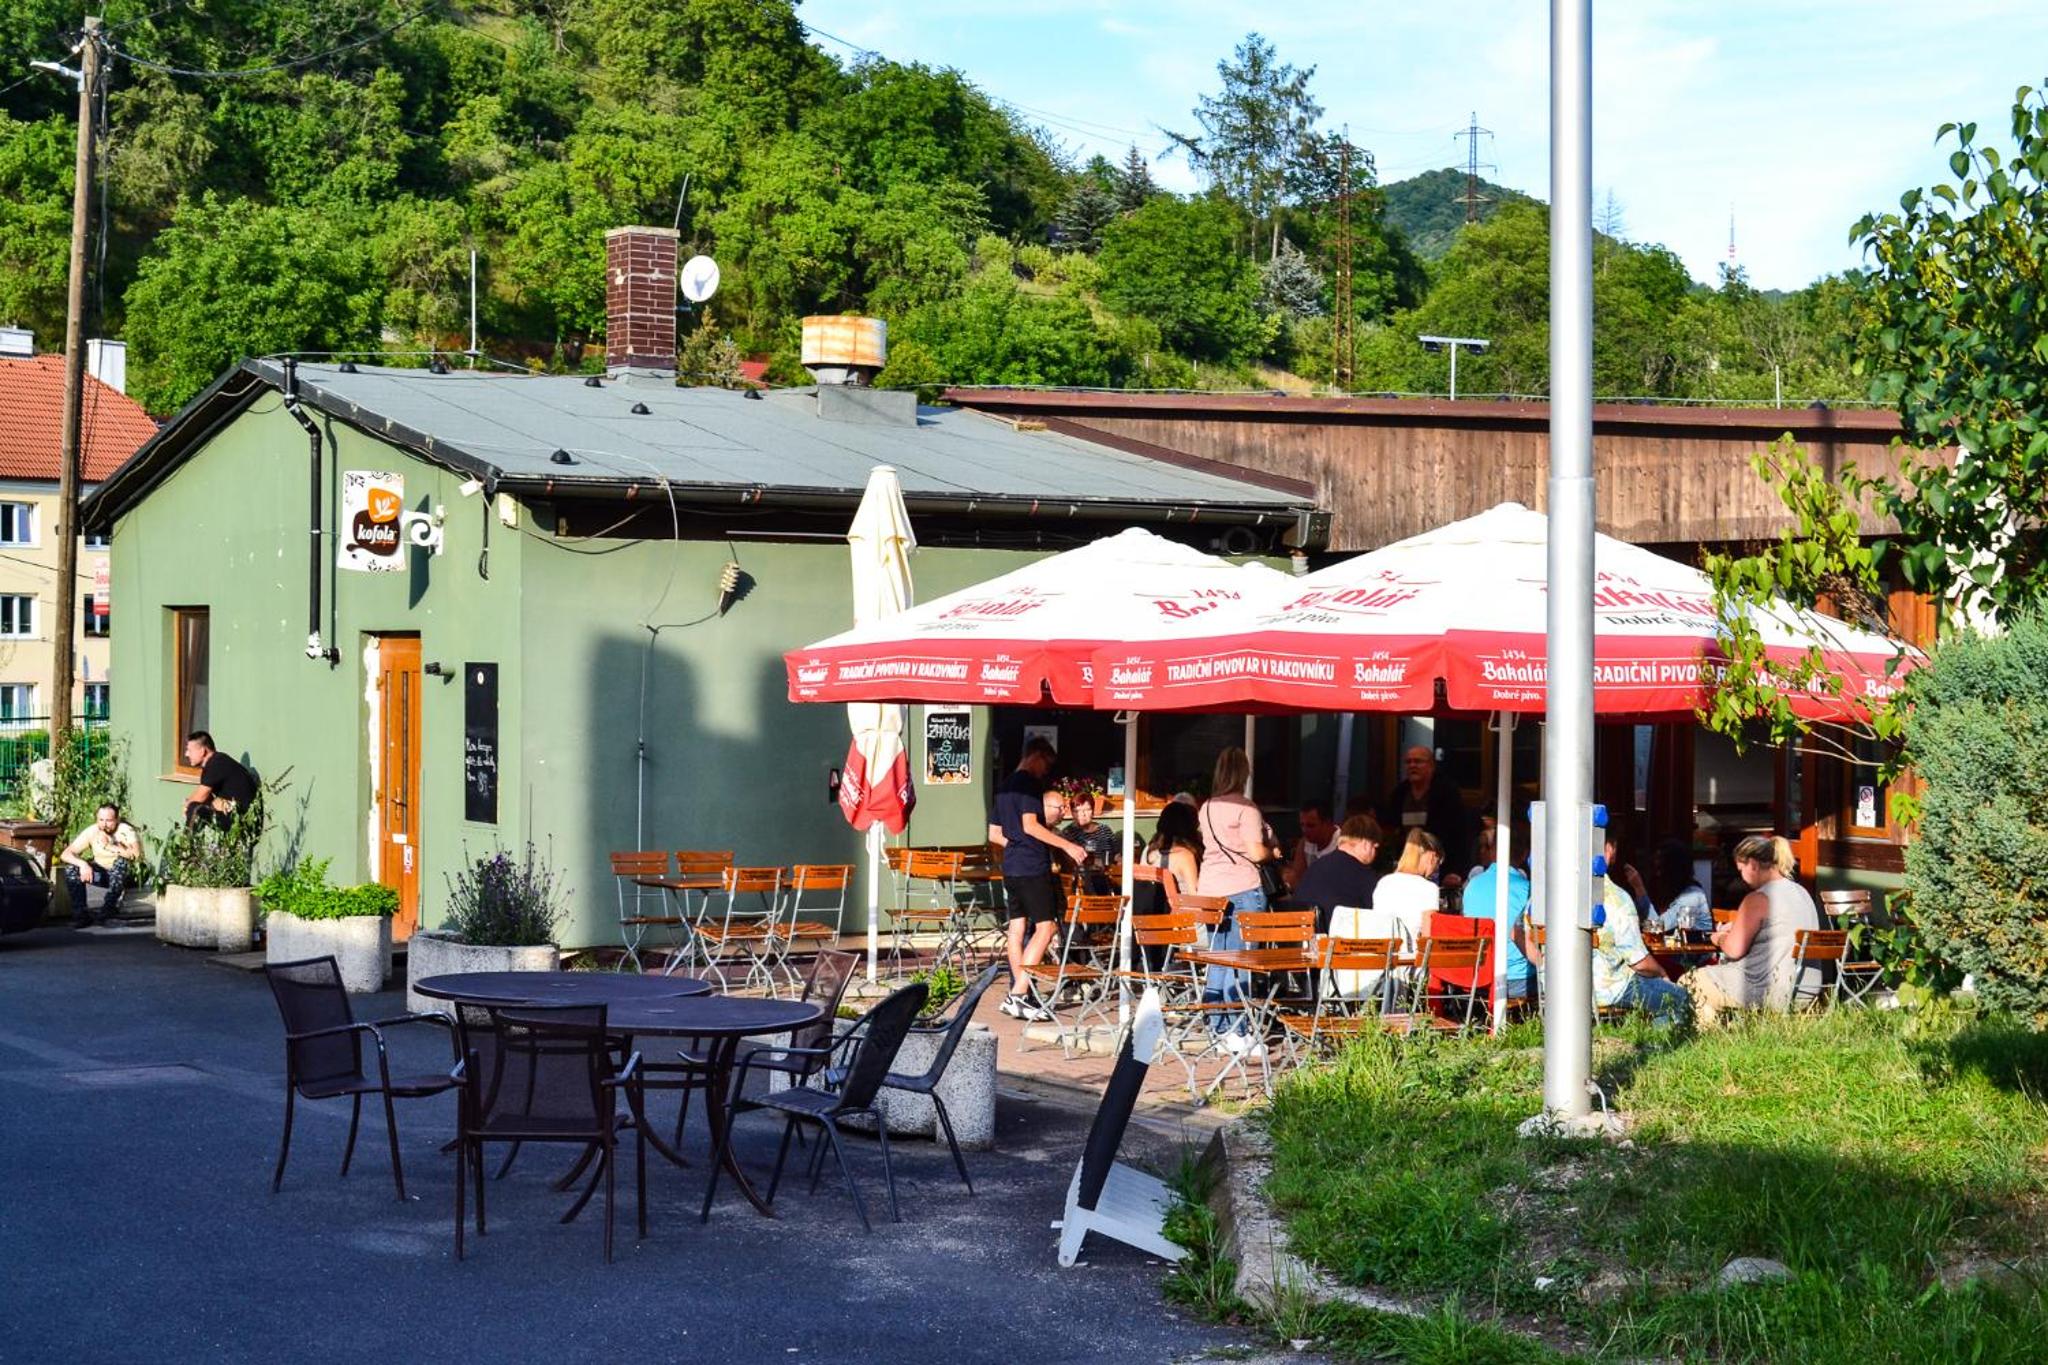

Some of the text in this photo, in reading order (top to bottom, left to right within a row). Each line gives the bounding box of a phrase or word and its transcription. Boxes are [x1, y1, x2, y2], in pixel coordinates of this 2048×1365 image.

[357, 523, 395, 545] kofola
[838, 661, 968, 680] TRADIČNÍ PIVOVAR V RAKOVNÍKU
[1167, 656, 1335, 681] TRADIČNÍ PIVOVAR V RAKOVNÍKU
[1594, 660, 1657, 683] RADIČNÍ
[1661, 664, 1728, 684] PIVOR
[1493, 690, 1519, 700] Dobré
